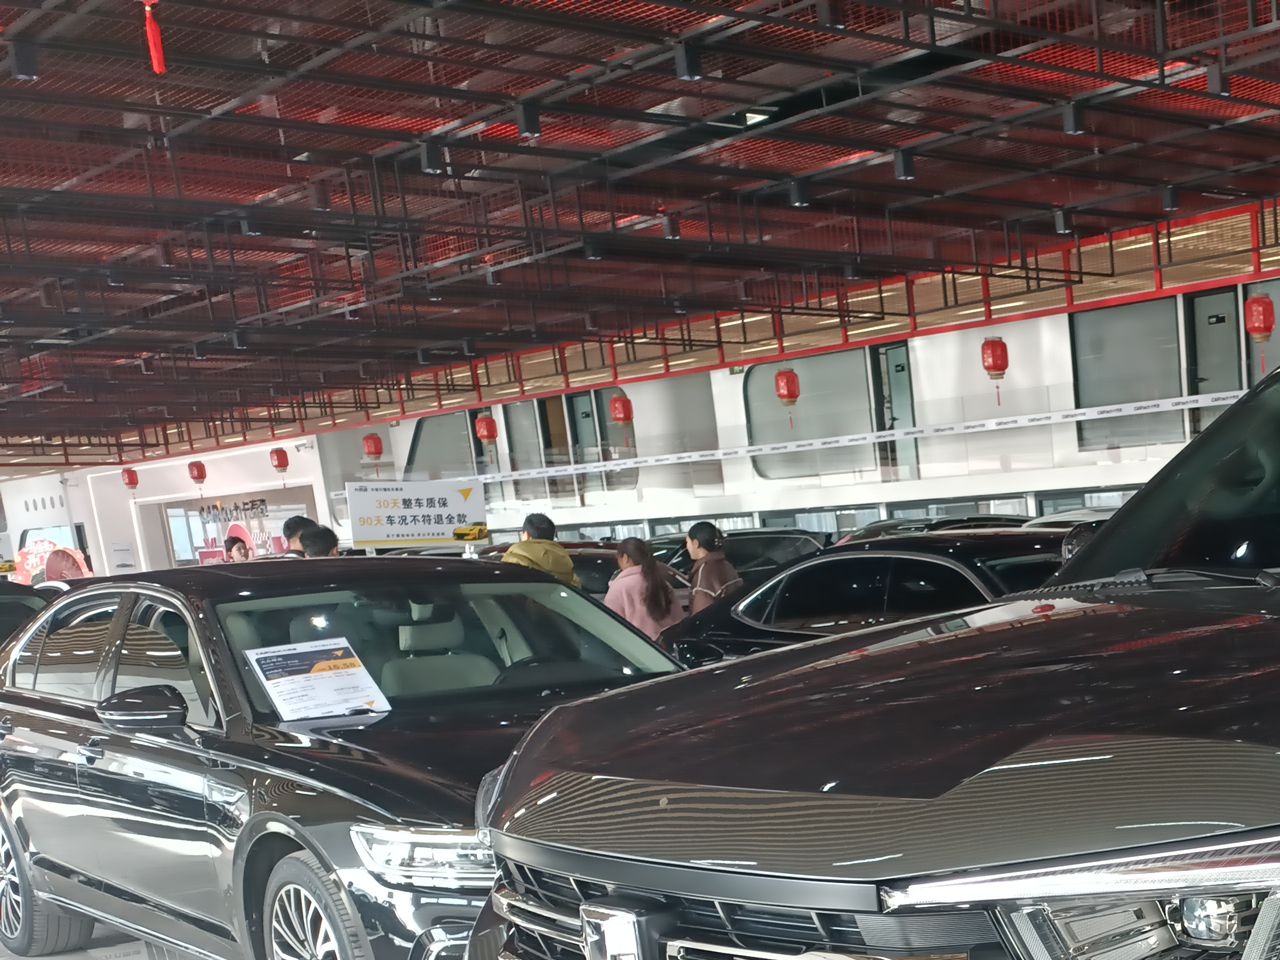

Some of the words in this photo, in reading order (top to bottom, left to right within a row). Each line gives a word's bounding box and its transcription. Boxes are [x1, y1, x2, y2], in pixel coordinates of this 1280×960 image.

[375, 497, 449, 510] 30天整车质保
[358, 513, 468, 527] 90天车况不符退全款
